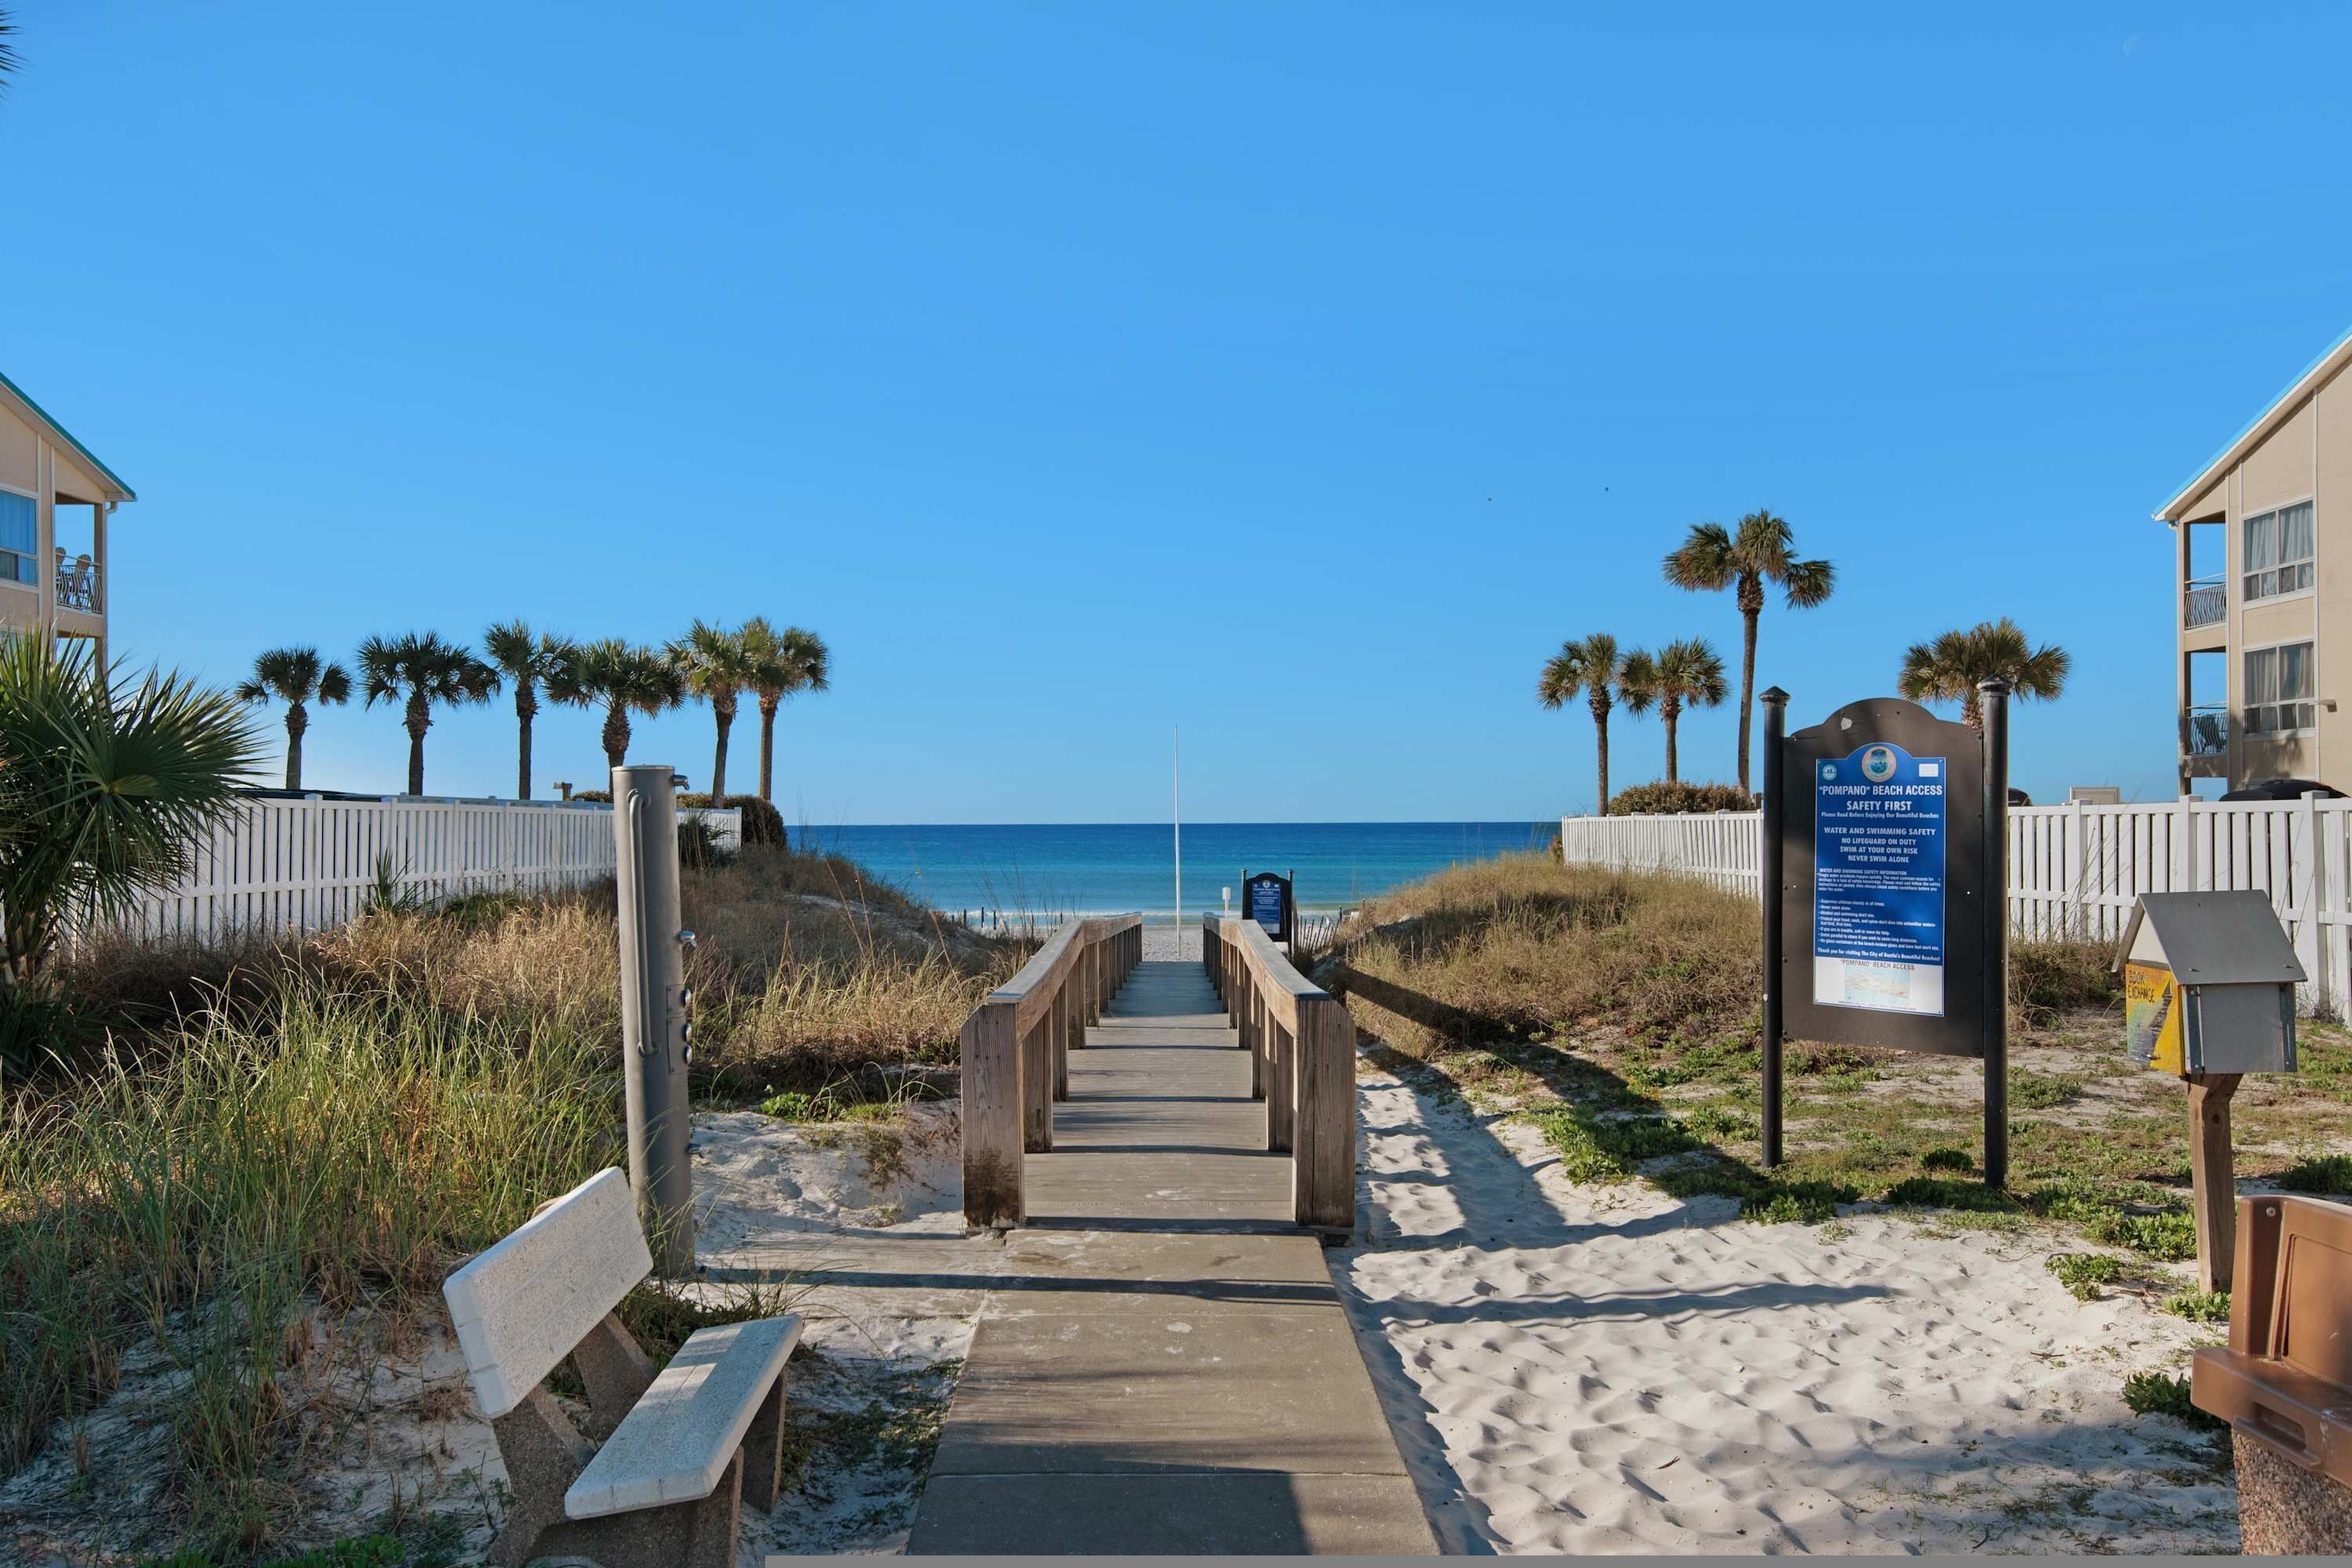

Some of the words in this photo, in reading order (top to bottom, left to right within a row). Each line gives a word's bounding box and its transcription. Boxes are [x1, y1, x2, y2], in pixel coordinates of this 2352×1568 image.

[1819, 786, 1870, 795] "POMPANO"
[1873, 786, 1902, 795] BEACH
[1906, 786, 1942, 795] ACCESS
[1847, 801, 1881, 811] SAFETY
[1884, 801, 1912, 811] FIRST
[2129, 970, 2145, 985] BOOK
[2128, 984, 2155, 1003] EXCHANGE
